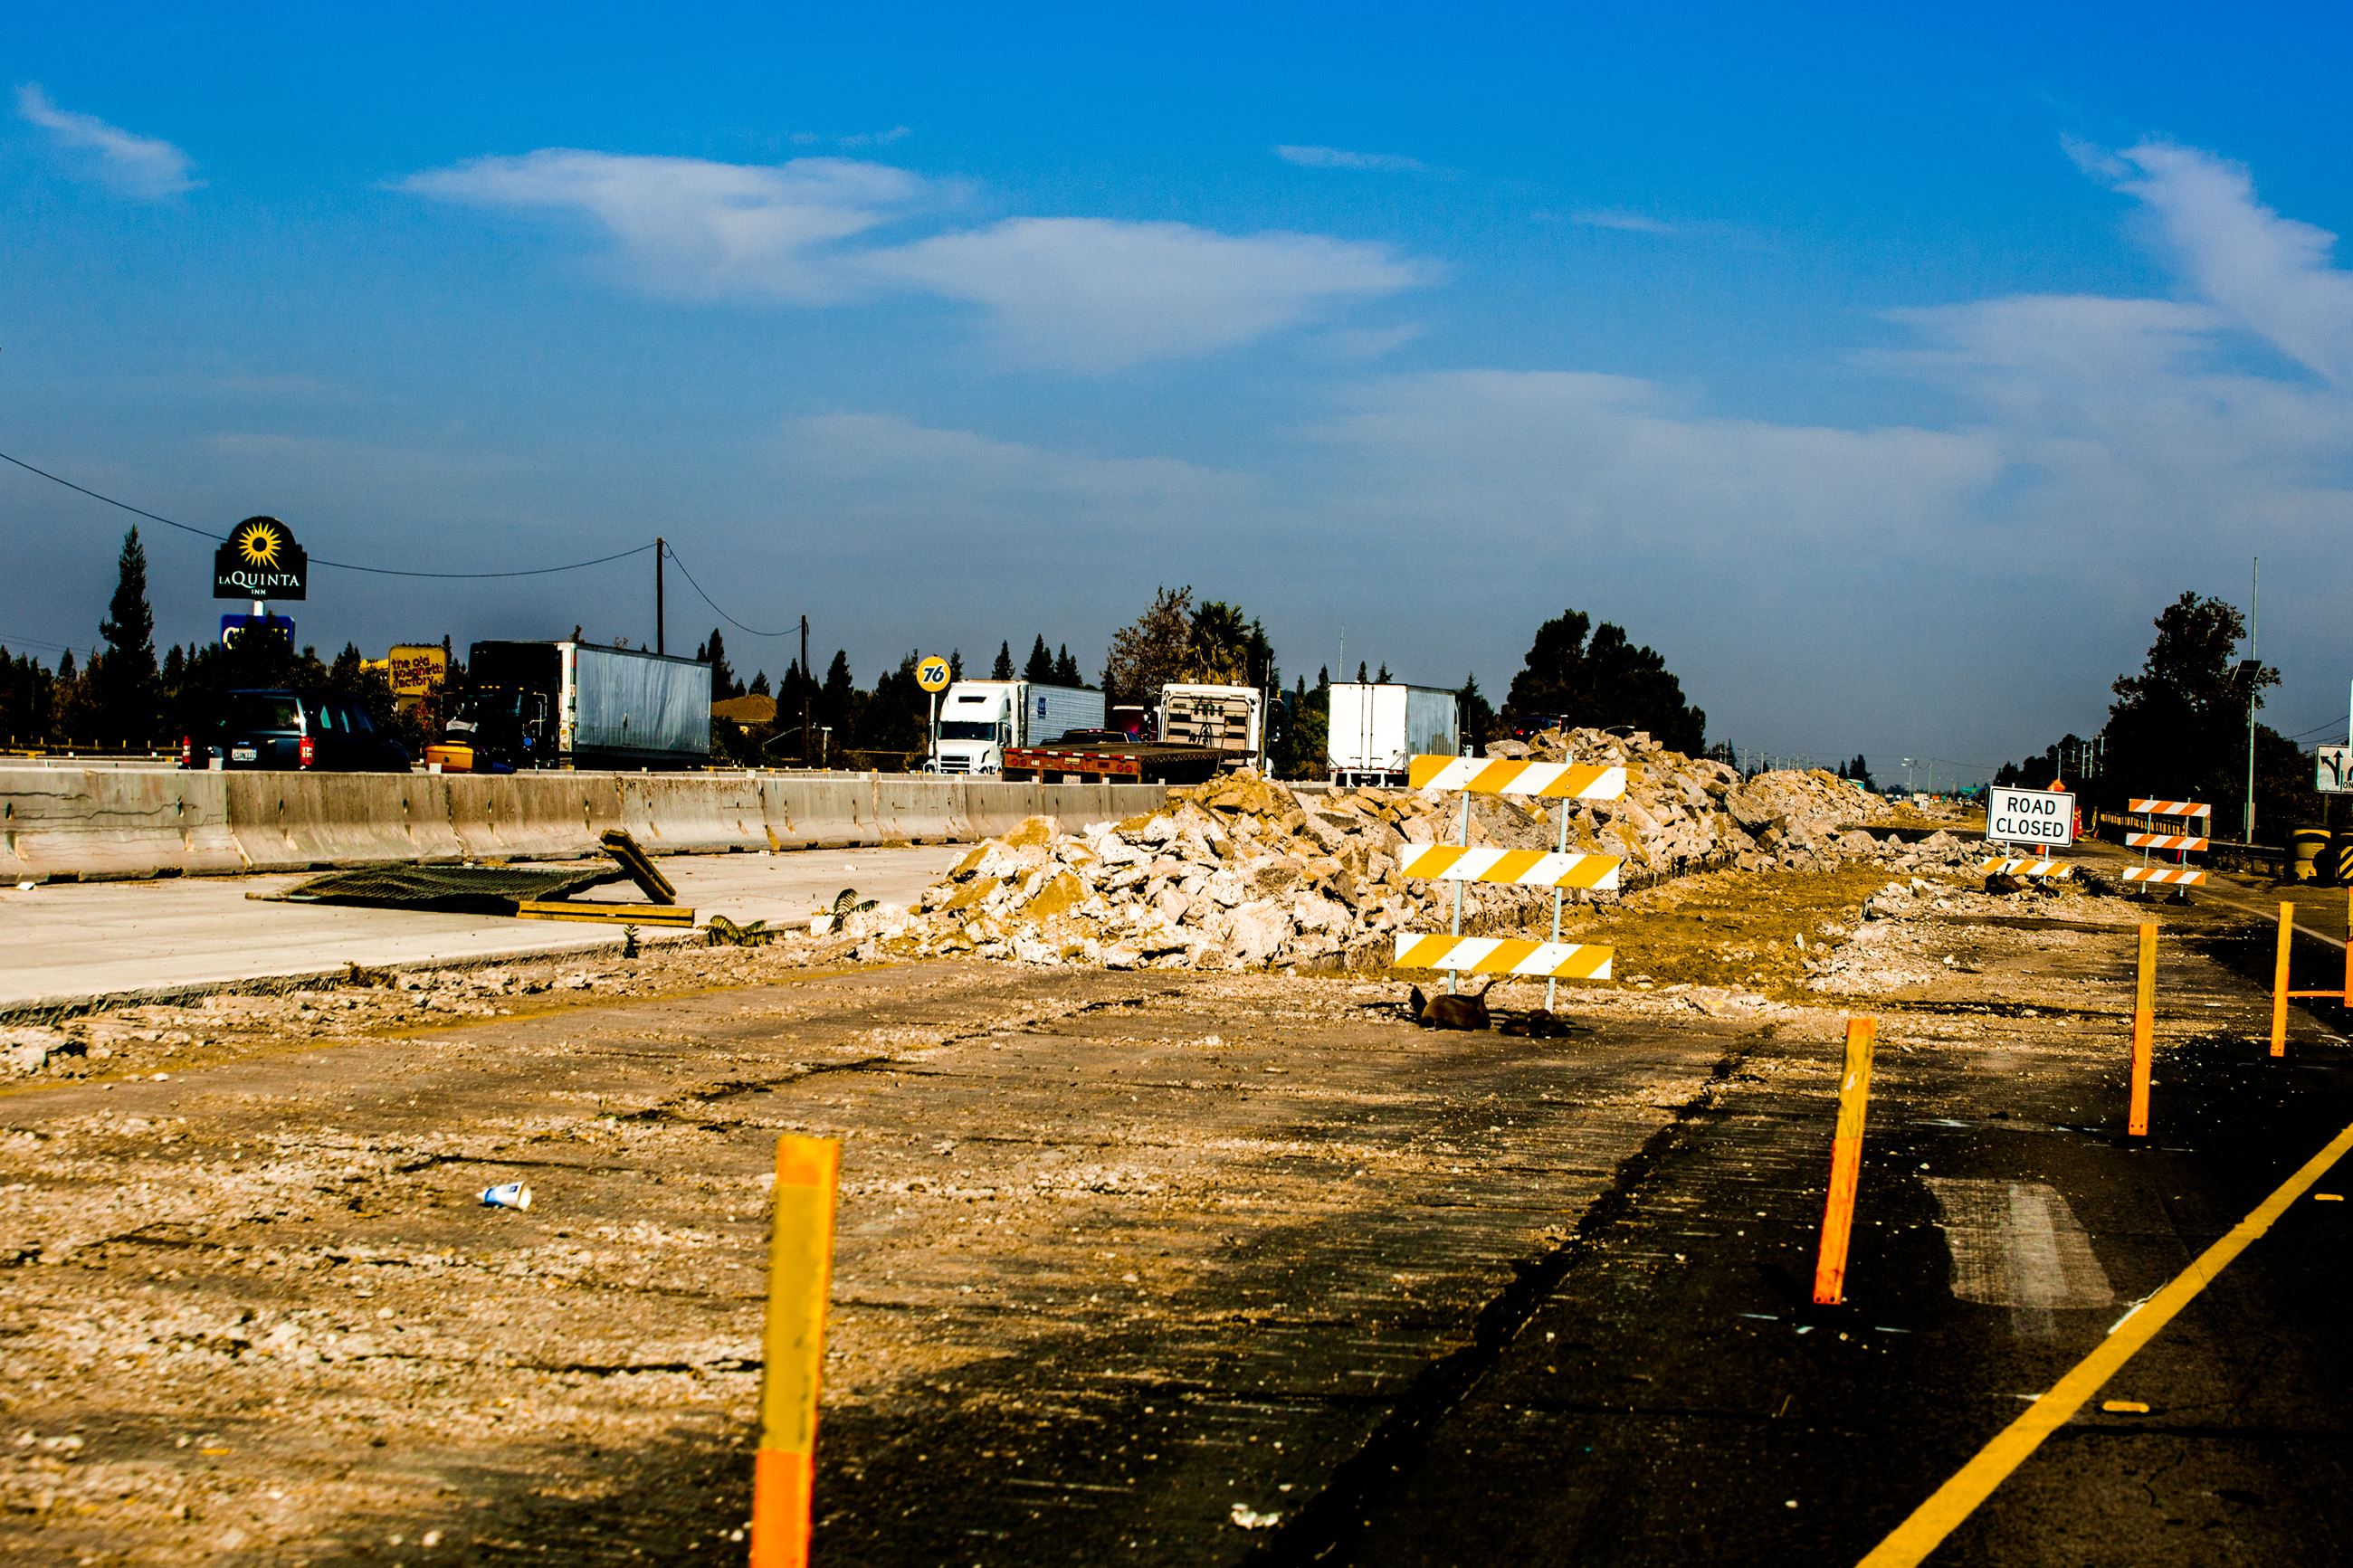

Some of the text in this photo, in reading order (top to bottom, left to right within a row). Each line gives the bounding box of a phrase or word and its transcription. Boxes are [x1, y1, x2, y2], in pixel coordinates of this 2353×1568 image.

[391, 655, 430, 669] the old
[393, 663, 443, 679] spaghetti
[923, 665, 945, 683] 76
[2007, 796, 2056, 815] ROAD
[1996, 818, 2063, 837] CLOSED
